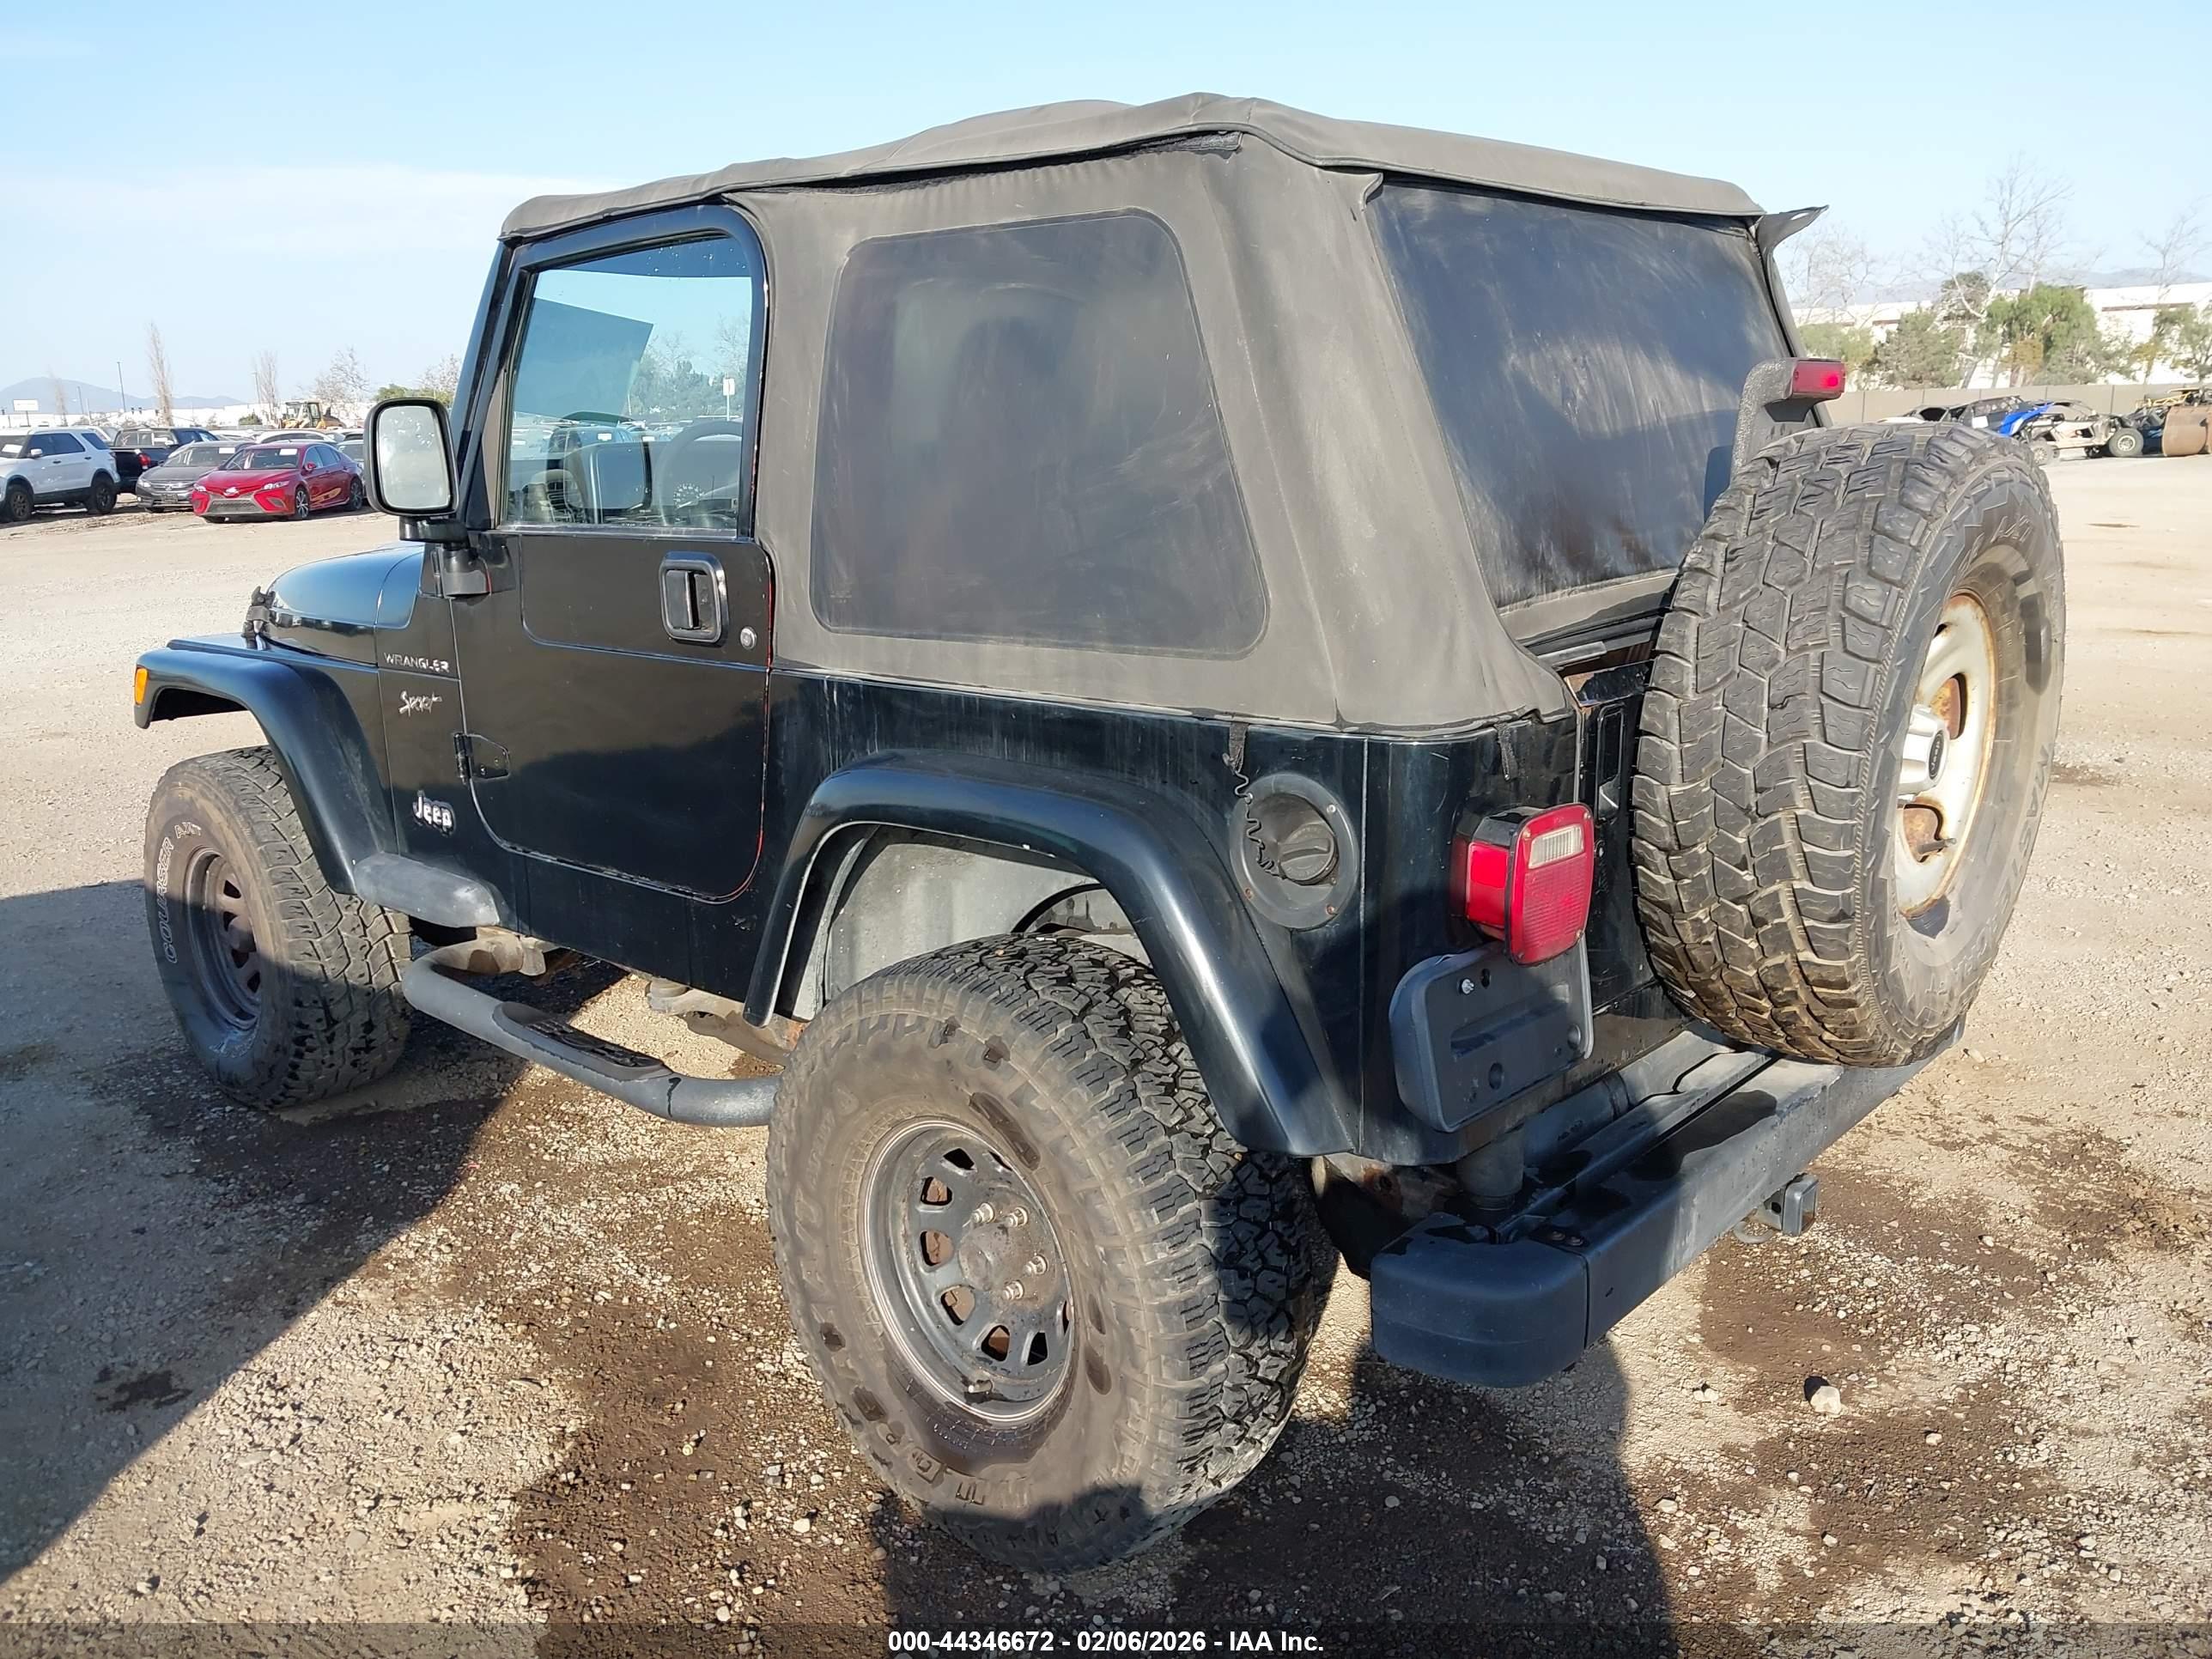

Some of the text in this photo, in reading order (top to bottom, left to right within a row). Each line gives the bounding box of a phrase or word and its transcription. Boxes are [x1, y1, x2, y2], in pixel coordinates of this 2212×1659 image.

[383, 652, 450, 672] WRANGLER
[398, 690, 443, 717] Sport
[414, 792, 454, 834] Jeep
[156, 836, 178, 963] COURSER
